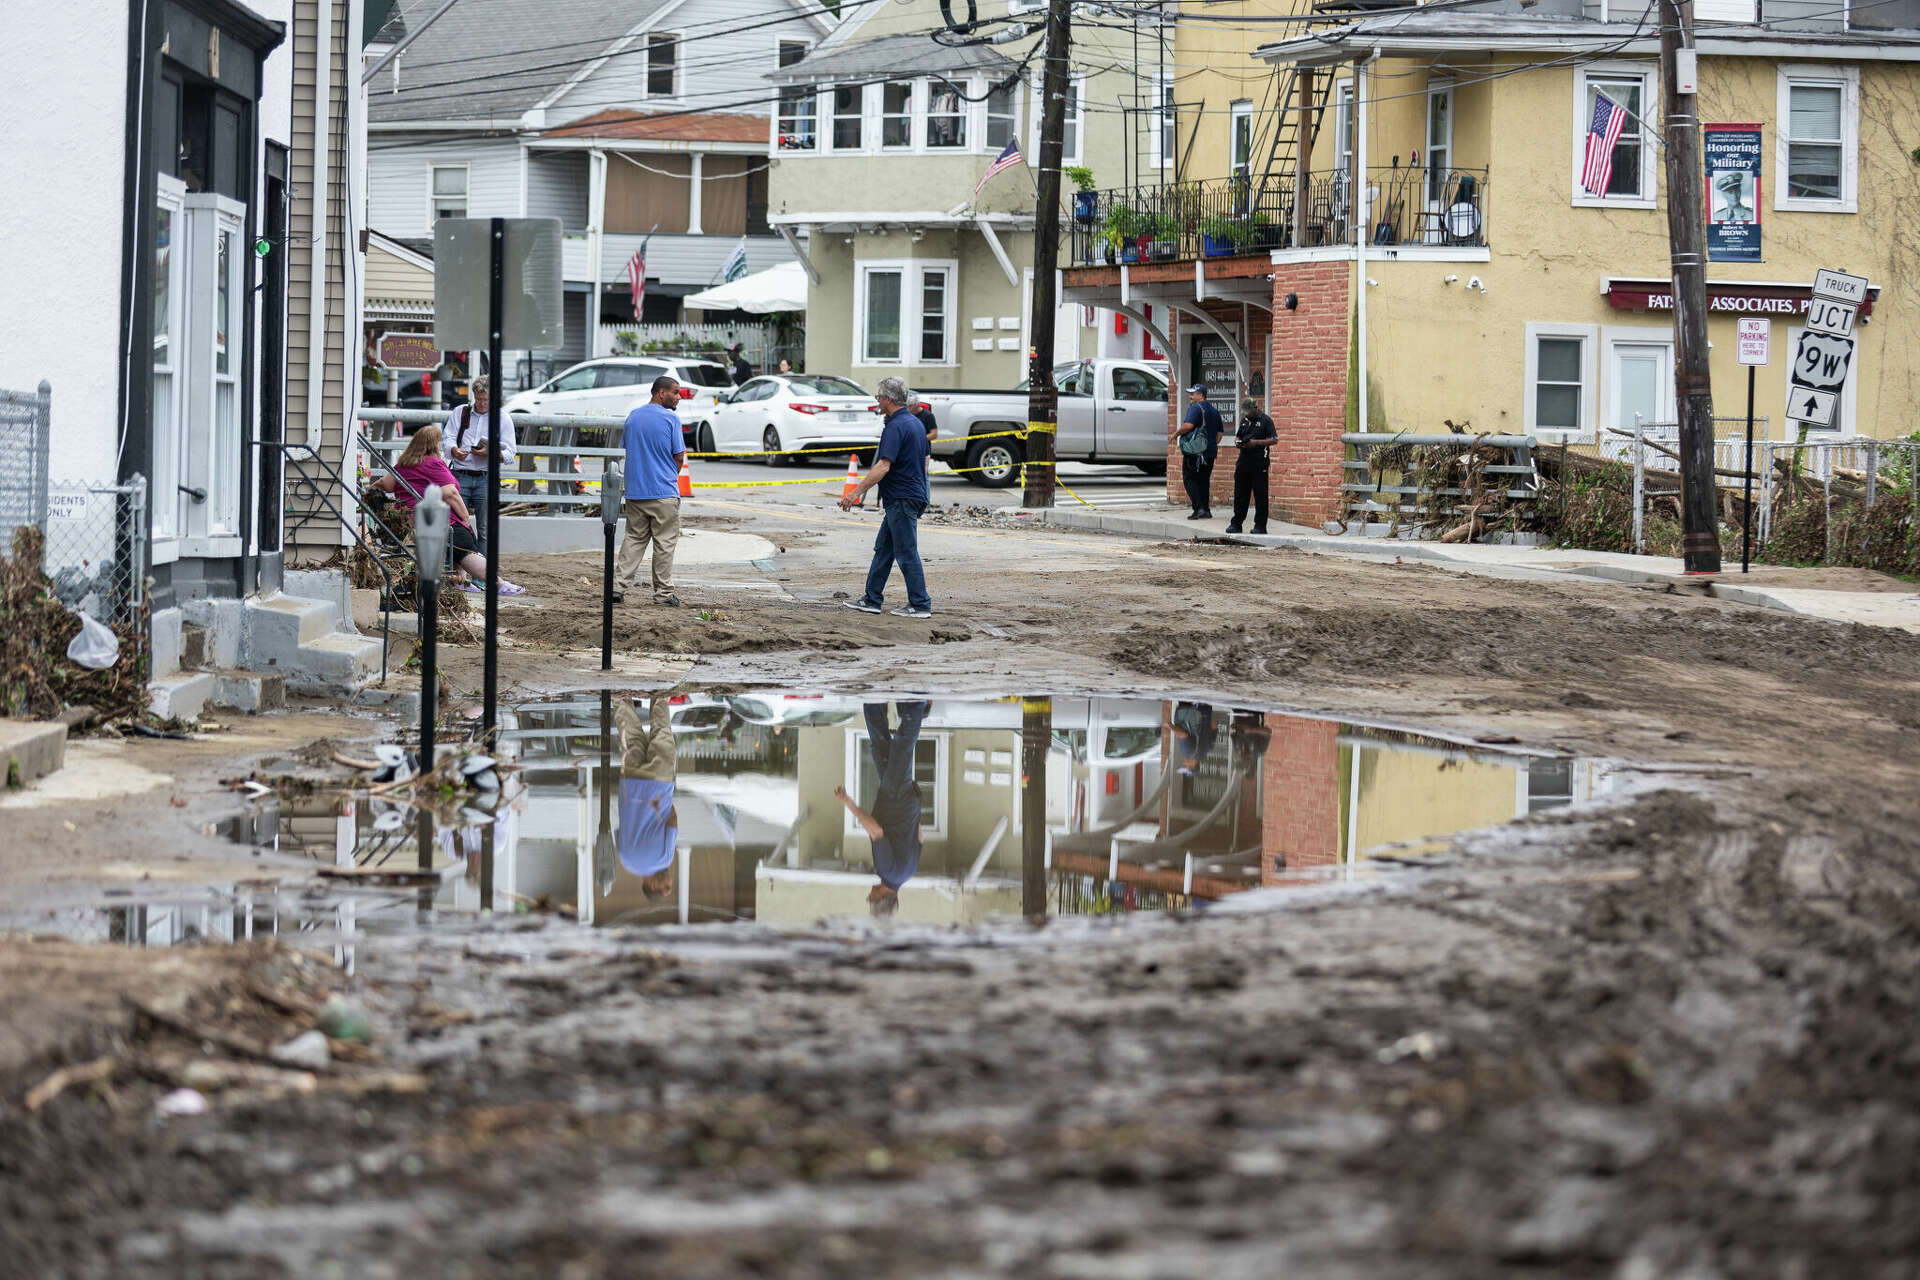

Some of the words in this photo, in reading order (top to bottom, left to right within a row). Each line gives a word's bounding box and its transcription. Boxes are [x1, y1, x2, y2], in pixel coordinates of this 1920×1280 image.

[1707, 143, 1759, 155] Honoring
[1712, 158, 1753, 169] Military
[1825, 278, 1857, 294] TRUCK
[1648, 294, 1674, 308] FAT
[1710, 296, 1797, 314] ASSOCIATES,
[1810, 304, 1853, 330] JCT
[1748, 321, 1760, 331] NO
[1740, 331, 1768, 341] PARKING
[1805, 346, 1841, 378] 9W
